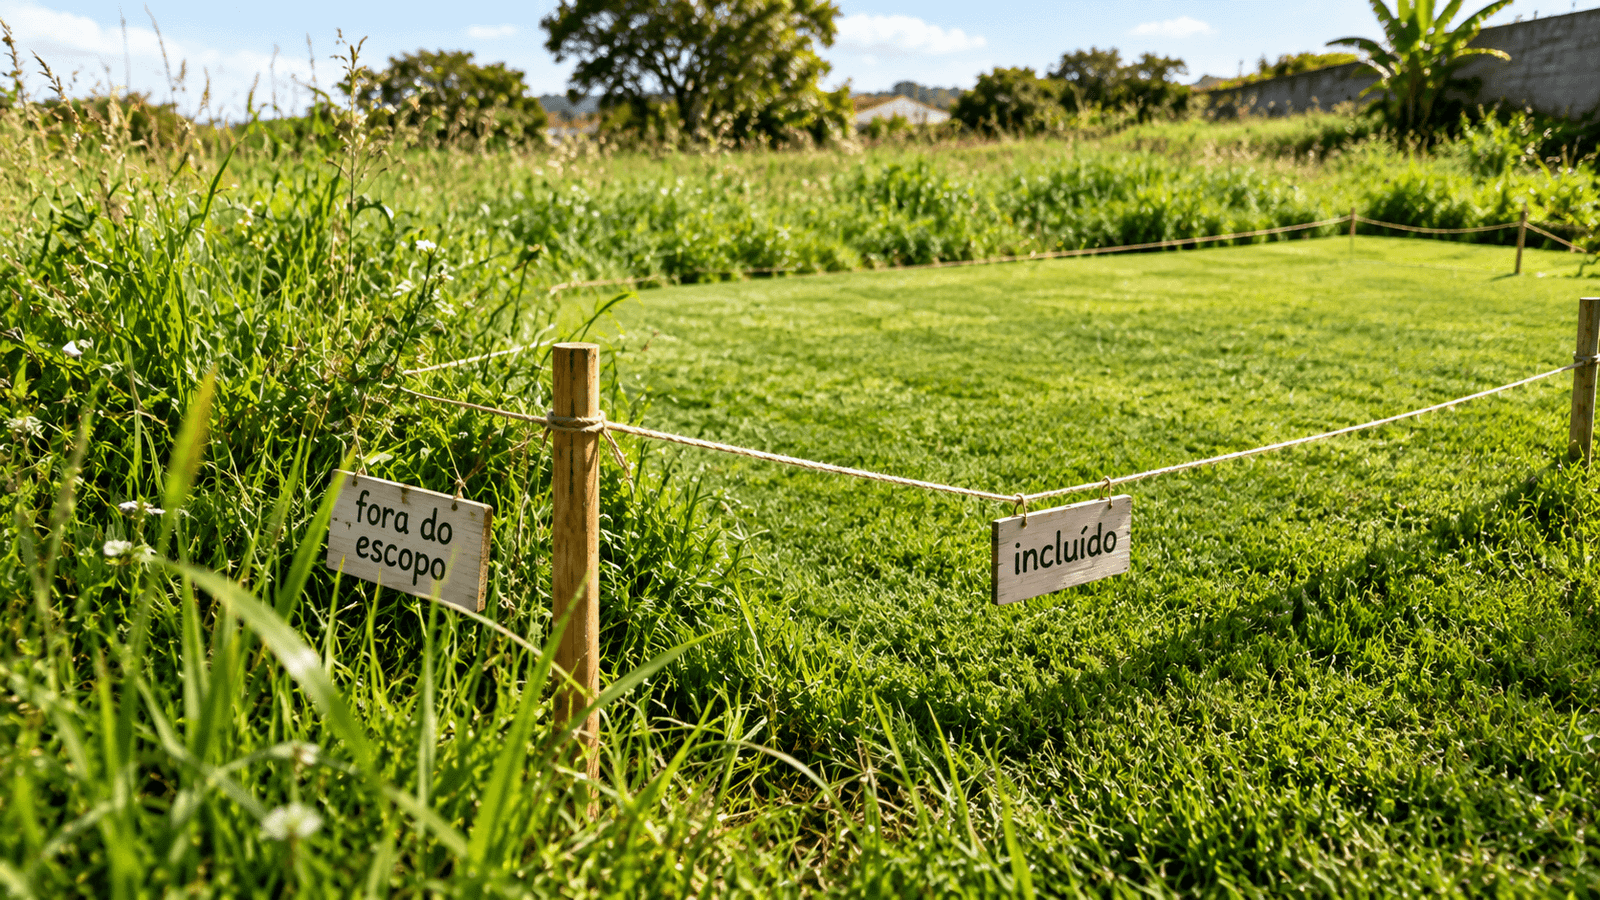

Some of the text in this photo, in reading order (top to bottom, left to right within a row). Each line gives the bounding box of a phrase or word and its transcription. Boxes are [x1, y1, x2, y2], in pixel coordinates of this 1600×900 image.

[356, 490, 453, 545] fora do
[355, 536, 446, 586] escopo
[1014, 522, 1117, 575] incluído
